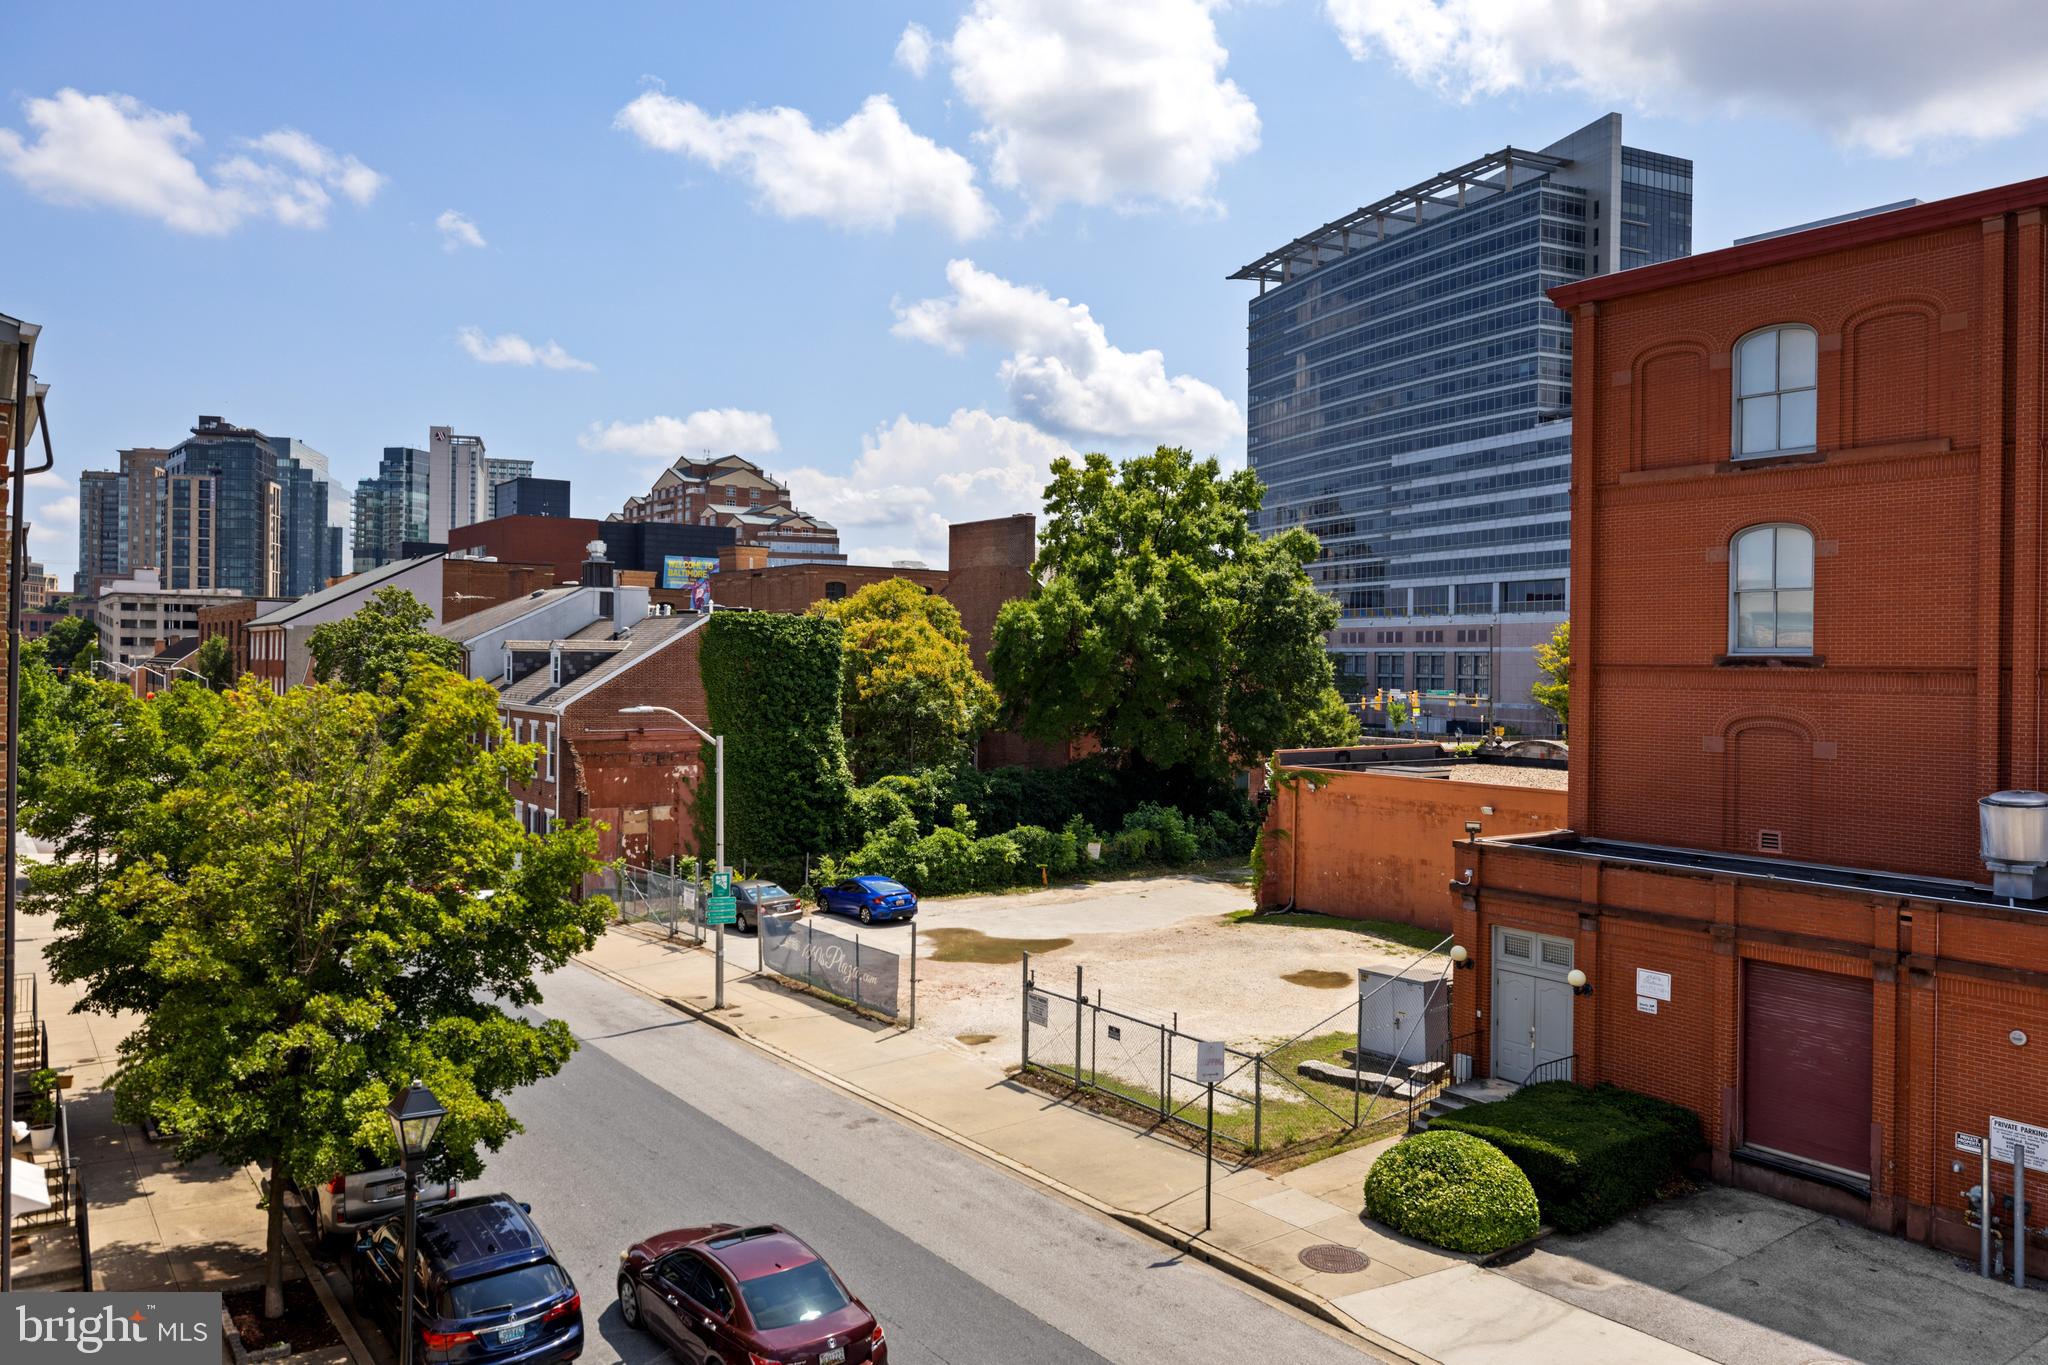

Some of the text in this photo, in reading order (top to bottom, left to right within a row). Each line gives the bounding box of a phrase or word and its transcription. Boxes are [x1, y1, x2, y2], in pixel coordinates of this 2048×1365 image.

[667, 560, 714, 570] WELCOME TO
[668, 568, 707, 578] BALTIMORE
[1994, 1120, 2018, 1132] PRIVATE
[2020, 1126, 2048, 1139] PARKING
